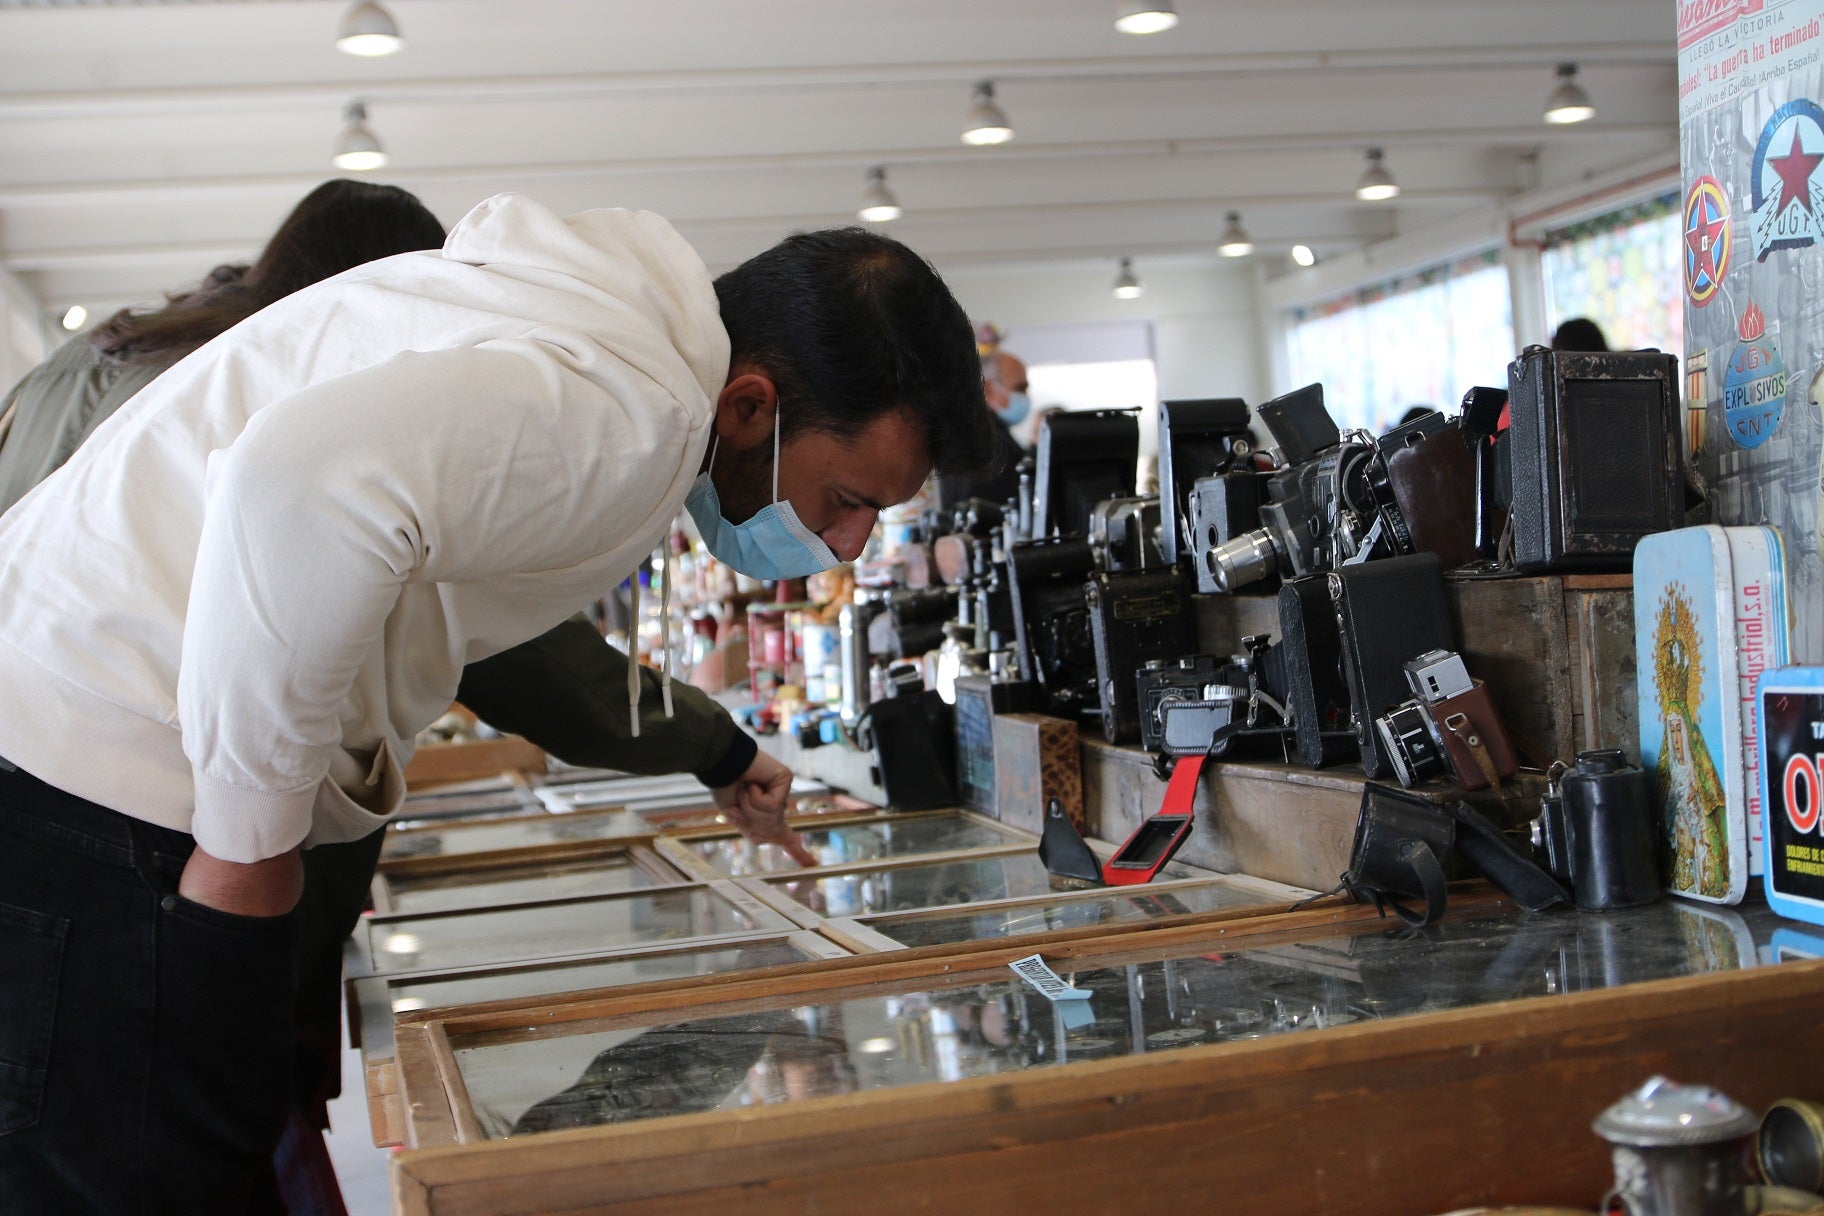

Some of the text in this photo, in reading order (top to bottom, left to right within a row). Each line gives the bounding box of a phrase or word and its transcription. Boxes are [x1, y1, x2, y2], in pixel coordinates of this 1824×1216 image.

[1718, 33, 1730, 48] LA
[1734, 10, 1784, 39] VICTORIA
[1721, 48, 1749, 80] guerra
[1752, 41, 1765, 63] ha
[1720, 87, 1727, 100] el
[1736, 411, 1773, 438] CNT
